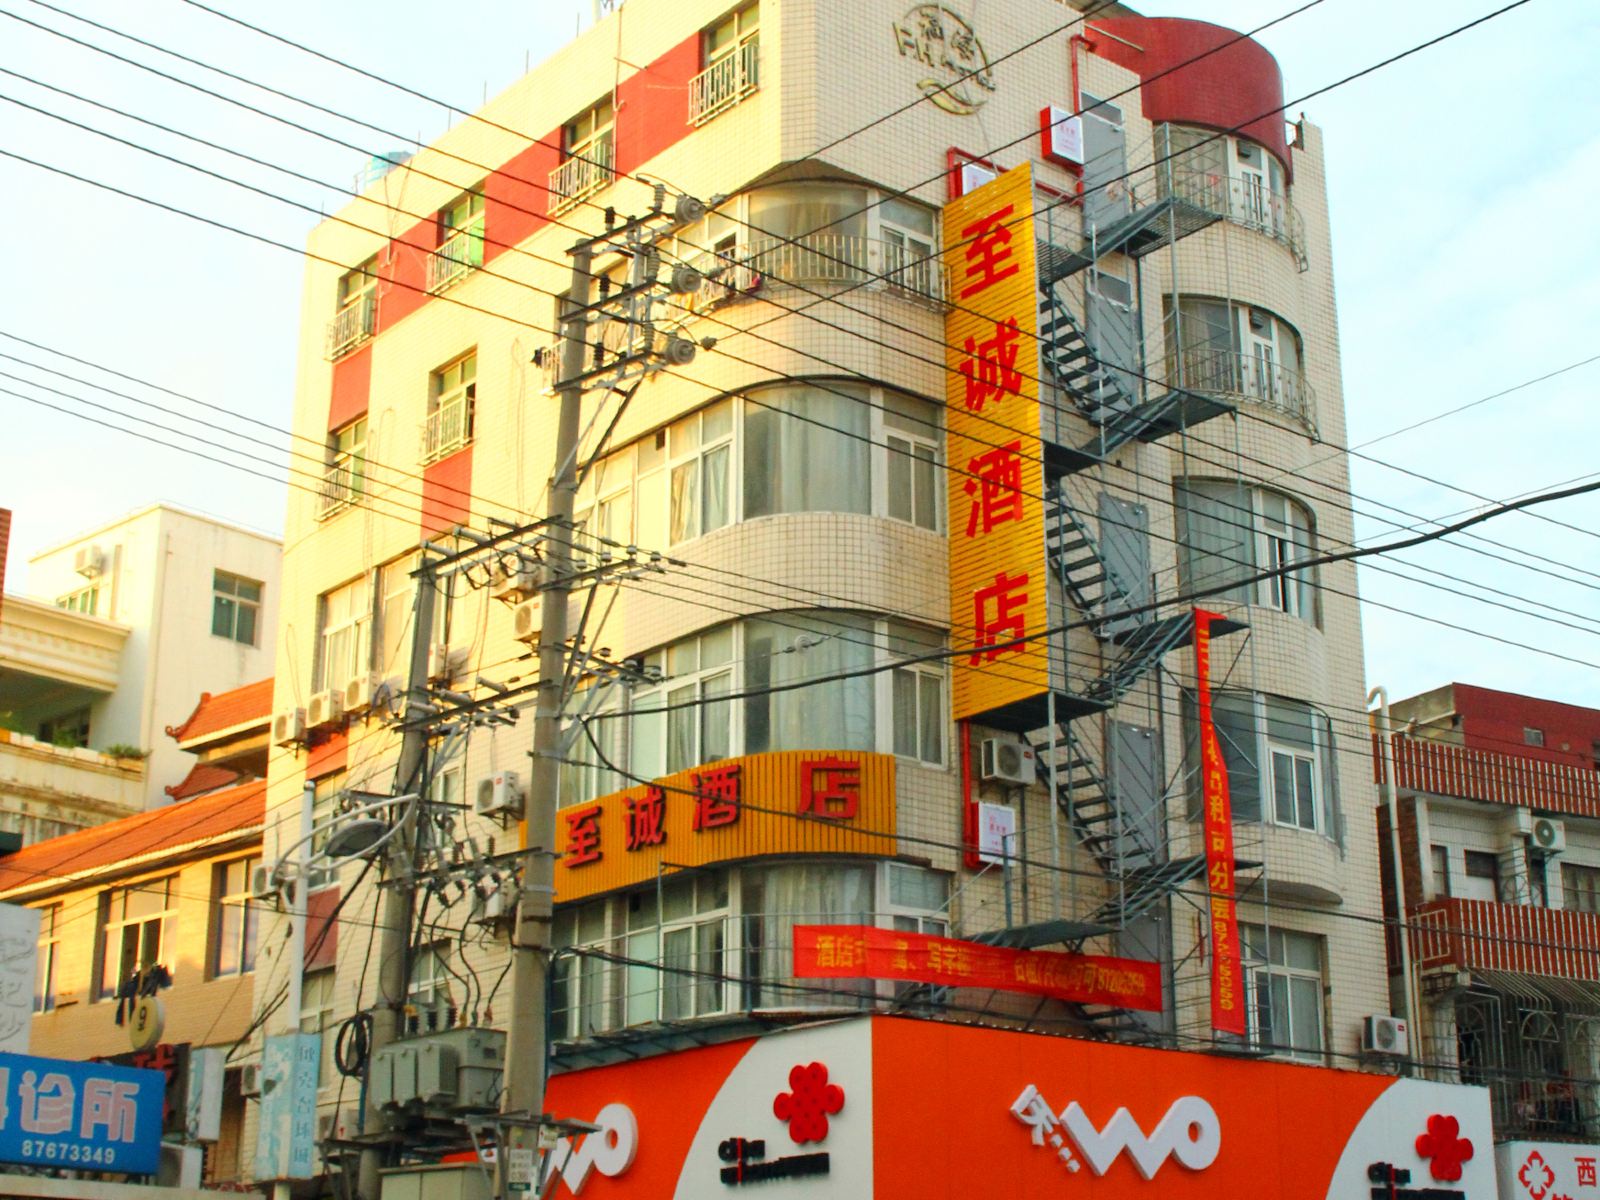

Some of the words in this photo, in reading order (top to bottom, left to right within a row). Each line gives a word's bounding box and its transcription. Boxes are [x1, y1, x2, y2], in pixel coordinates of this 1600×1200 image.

[961, 204, 1029, 667] 至诚酒店
[565, 757, 861, 868] 至诚酒店
[139, 1006, 147, 1023] 9
[22, 1140, 115, 1164] 87673349
[1574, 1157, 1597, 1187] 西
